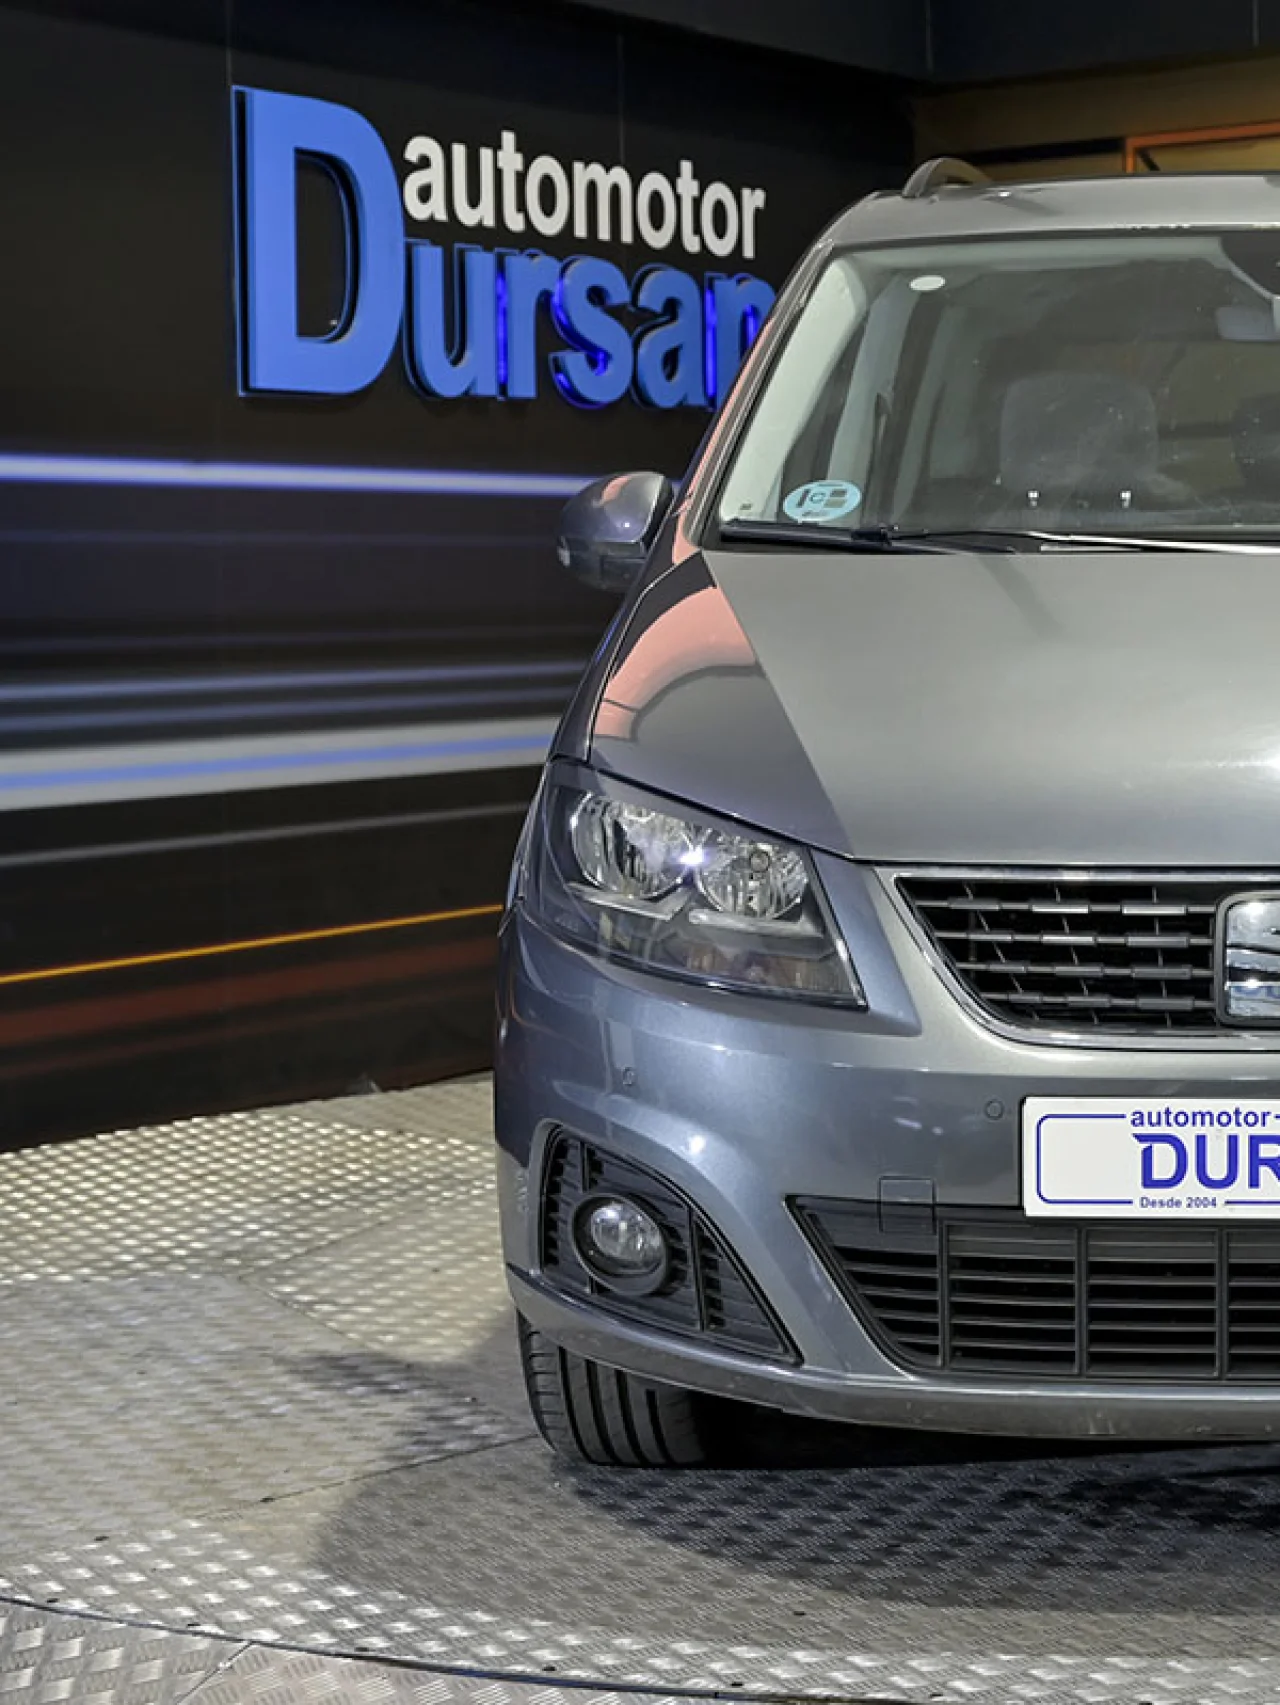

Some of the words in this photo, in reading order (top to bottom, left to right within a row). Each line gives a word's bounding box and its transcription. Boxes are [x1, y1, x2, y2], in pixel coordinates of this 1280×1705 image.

[403, 130, 766, 259] automotor
[1131, 1107, 1272, 1128] automotor
[1139, 1196, 1183, 1209] Desde
[1185, 1196, 1218, 1209] 2004
